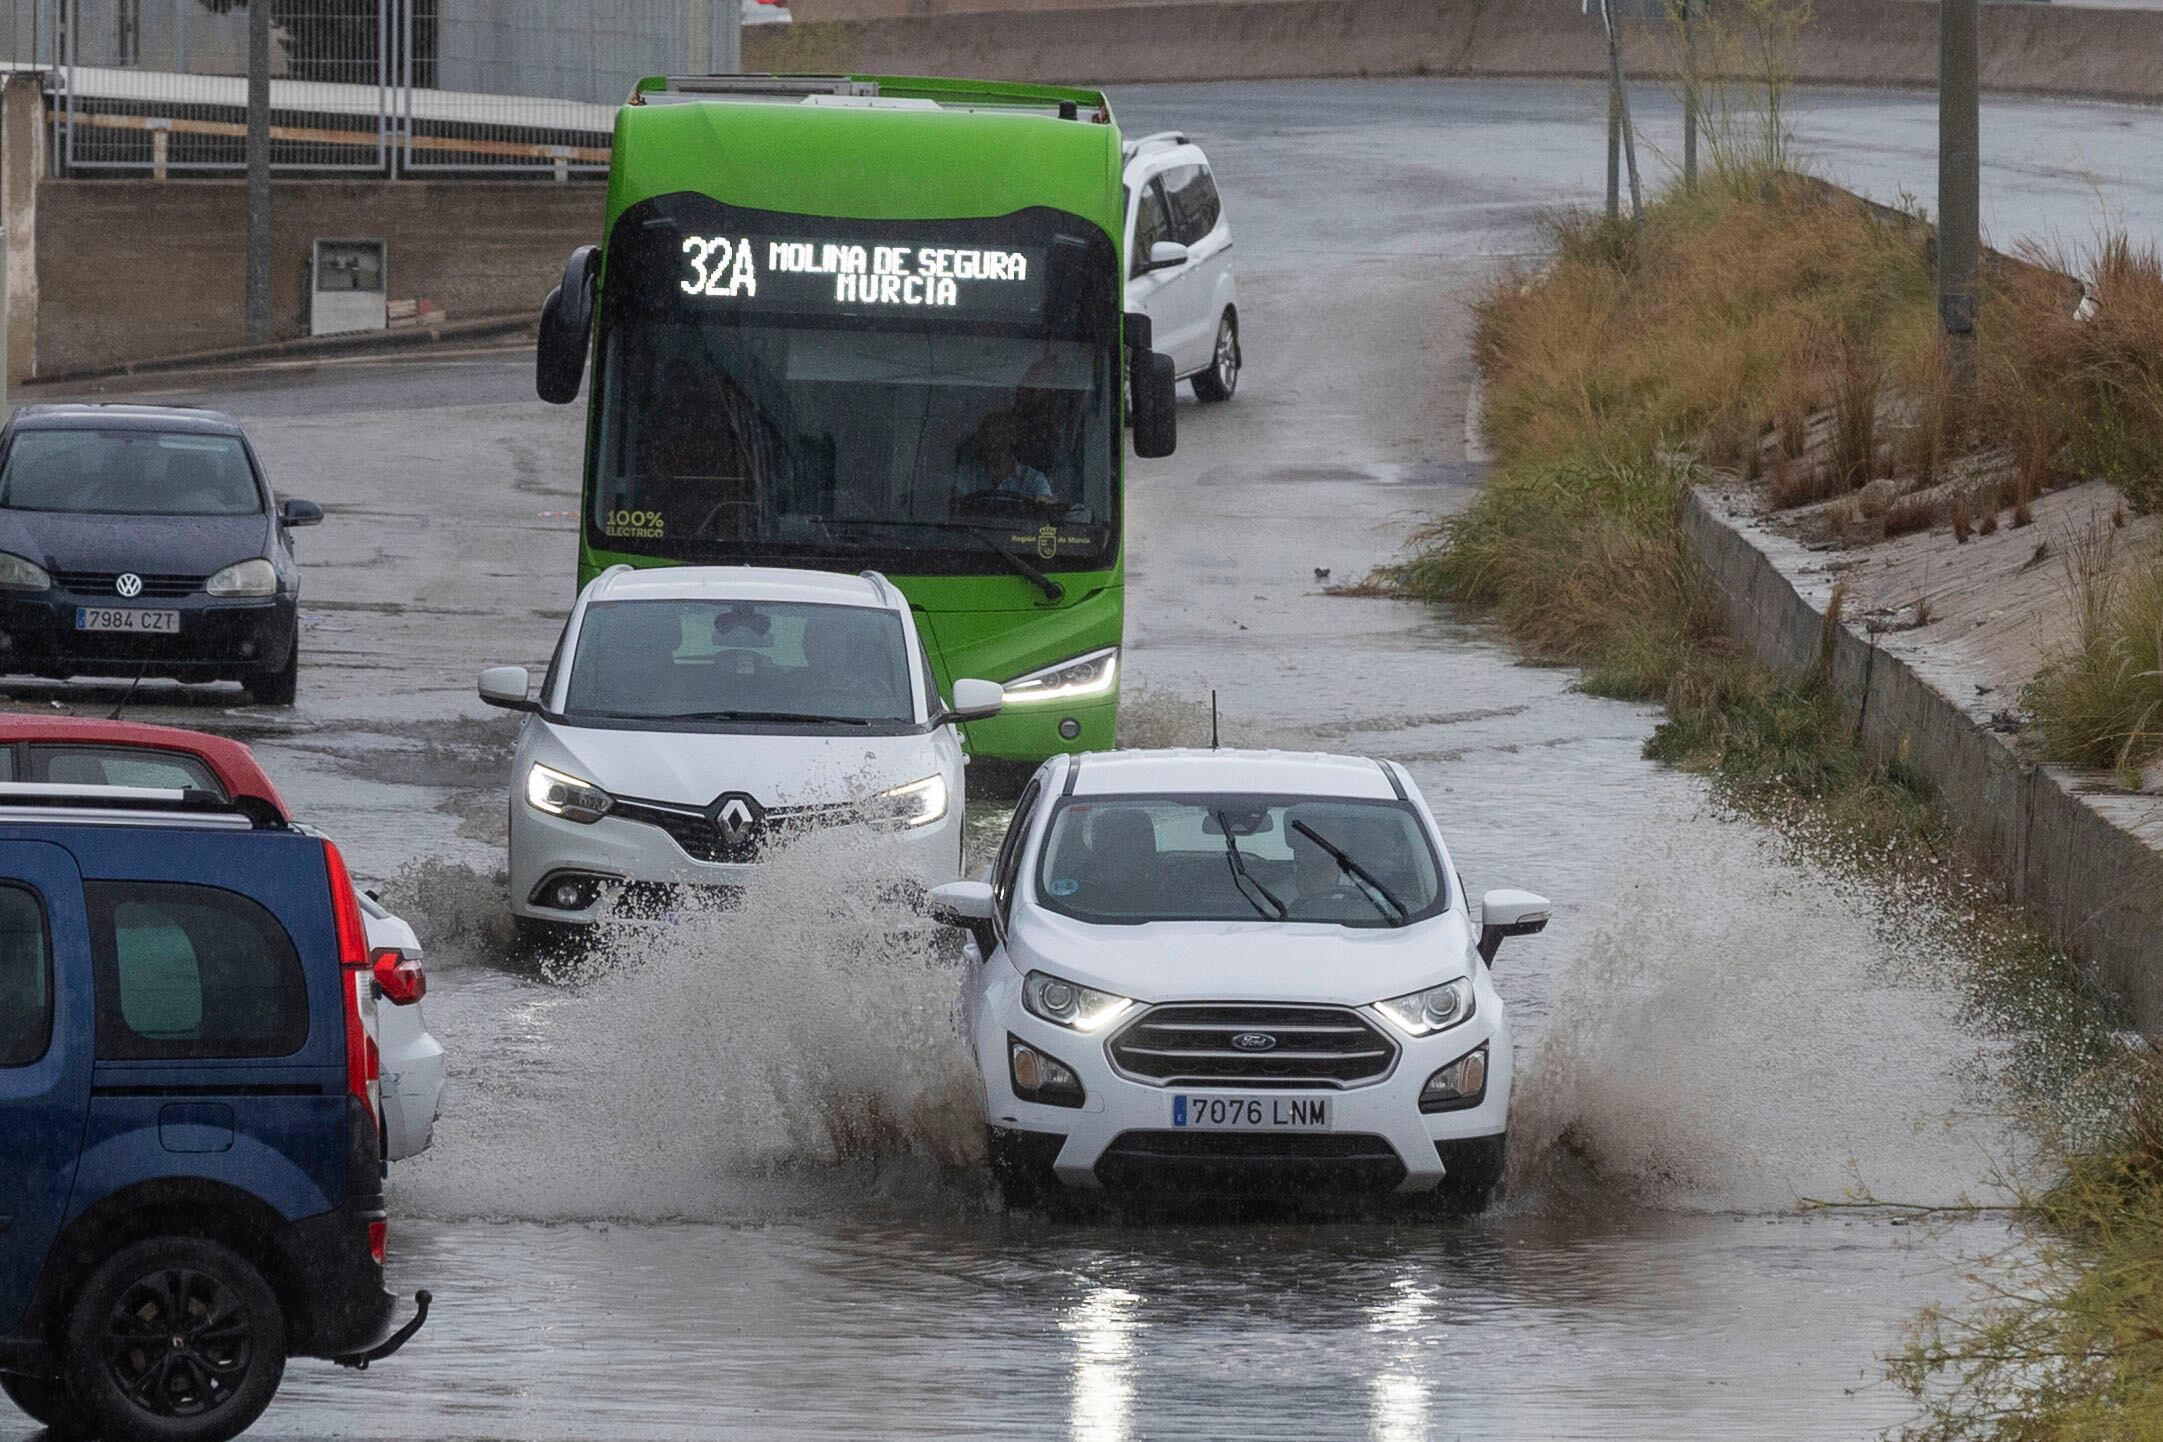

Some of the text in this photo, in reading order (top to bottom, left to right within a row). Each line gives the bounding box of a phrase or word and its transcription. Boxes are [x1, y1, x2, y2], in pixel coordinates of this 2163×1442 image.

[681, 236, 756, 296] 32A
[768, 242, 1027, 280] MOLINA DE SEGURA
[836, 273, 957, 305] MURCIA
[607, 510, 664, 527] 100%
[90, 611, 133, 628] 7984
[141, 612, 174, 629] CZT
[1241, 1035, 1267, 1046] Ford
[1192, 1099, 1325, 1125] 7076 LNM
